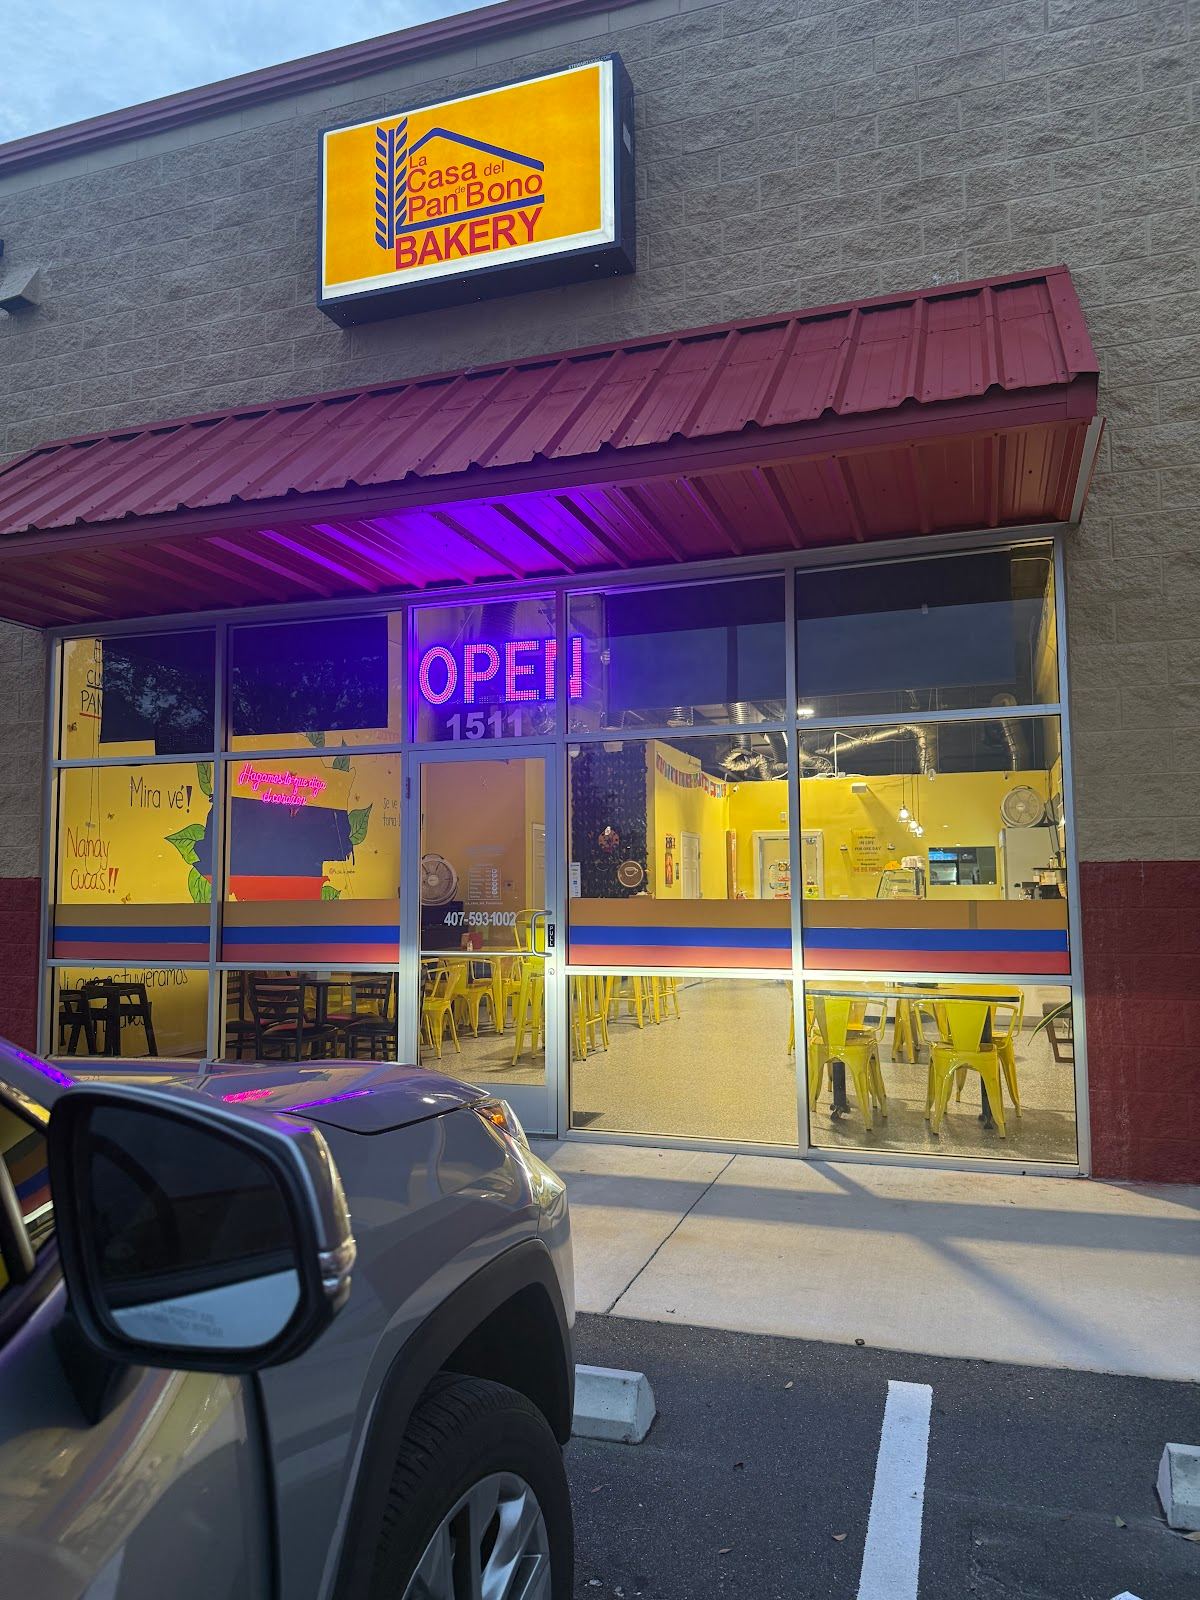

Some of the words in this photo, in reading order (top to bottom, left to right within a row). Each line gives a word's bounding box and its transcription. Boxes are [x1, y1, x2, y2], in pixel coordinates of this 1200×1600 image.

[407, 161, 476, 193] Casa
[483, 160, 504, 177] del
[410, 156, 427, 169] La
[408, 192, 458, 222] Pan
[455, 184, 466, 195] de
[466, 174, 543, 208] Bono
[395, 206, 543, 270] BAKERY
[419, 637, 582, 704] OPEN
[446, 708, 522, 741] 1511
[130, 775, 161, 808] Mira
[66, 826, 110, 870] Nanay
[444, 911, 516, 926] 407-593-1002
